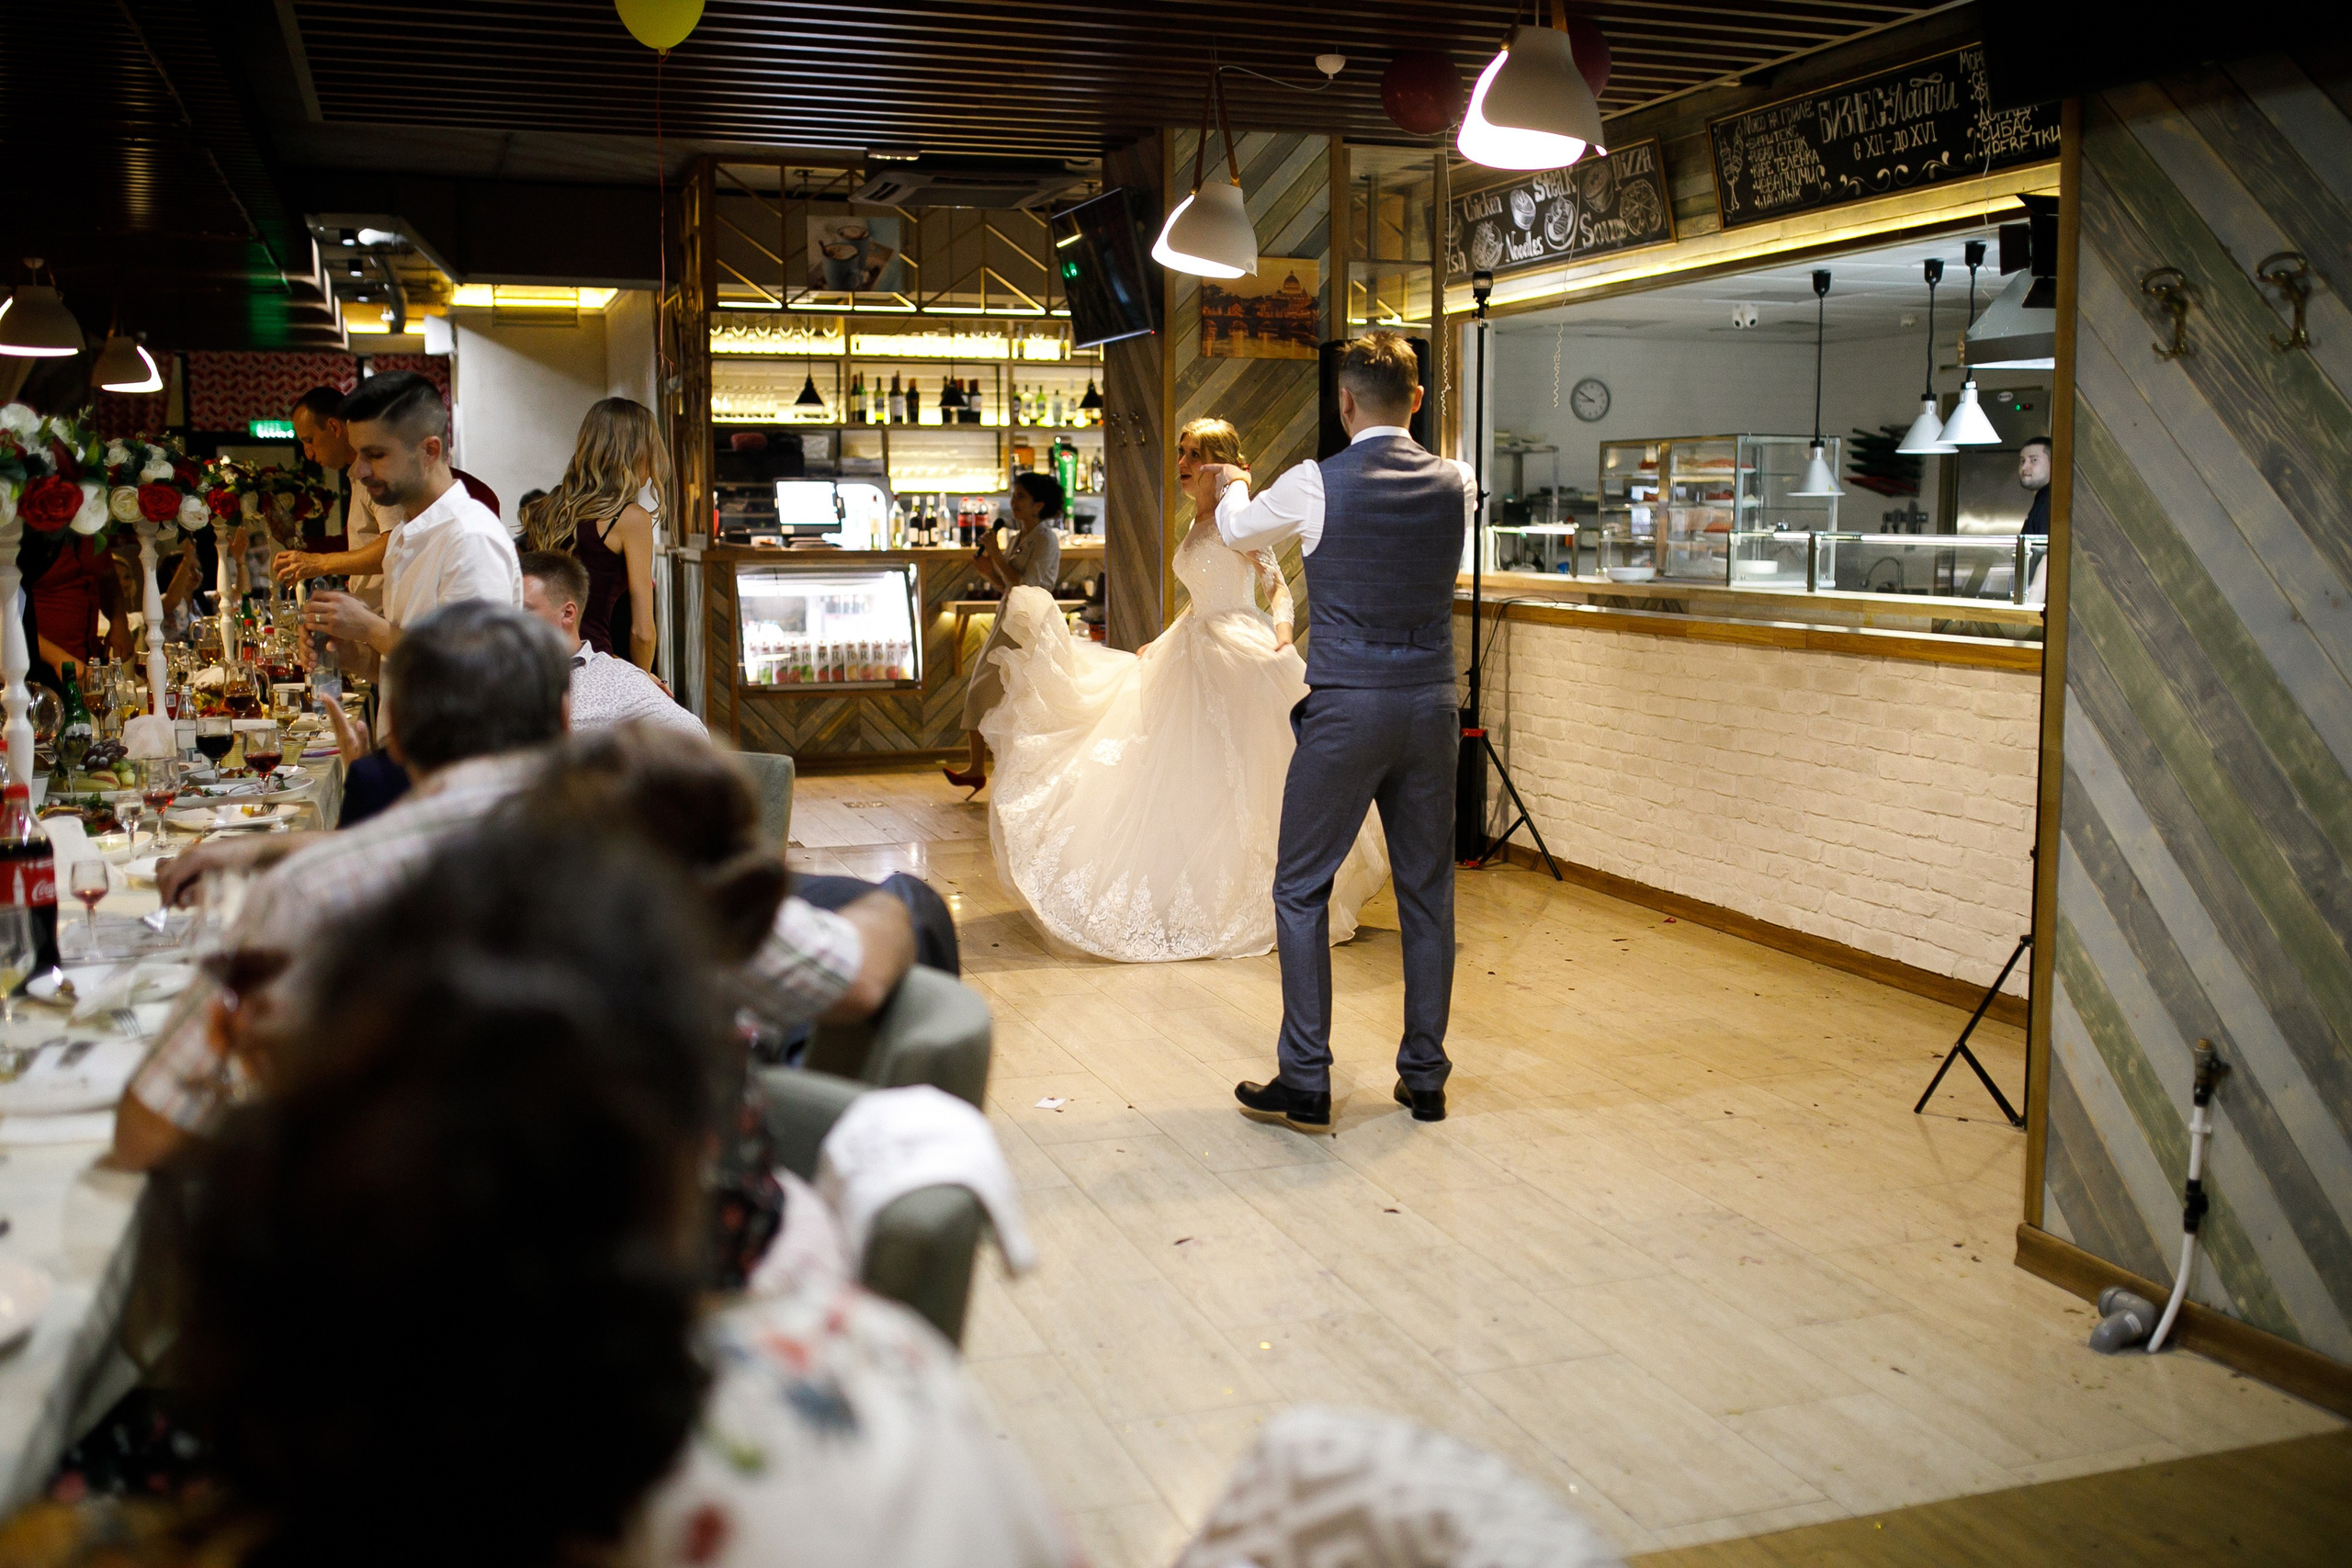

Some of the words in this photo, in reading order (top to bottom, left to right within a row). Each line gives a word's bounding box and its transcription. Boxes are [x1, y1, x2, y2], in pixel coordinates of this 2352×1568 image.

[1982, 117, 2033, 142] СИБАС
[1984, 125, 2061, 158] КРЕВЕТКИ
[1505, 231, 1544, 263] Noodles
